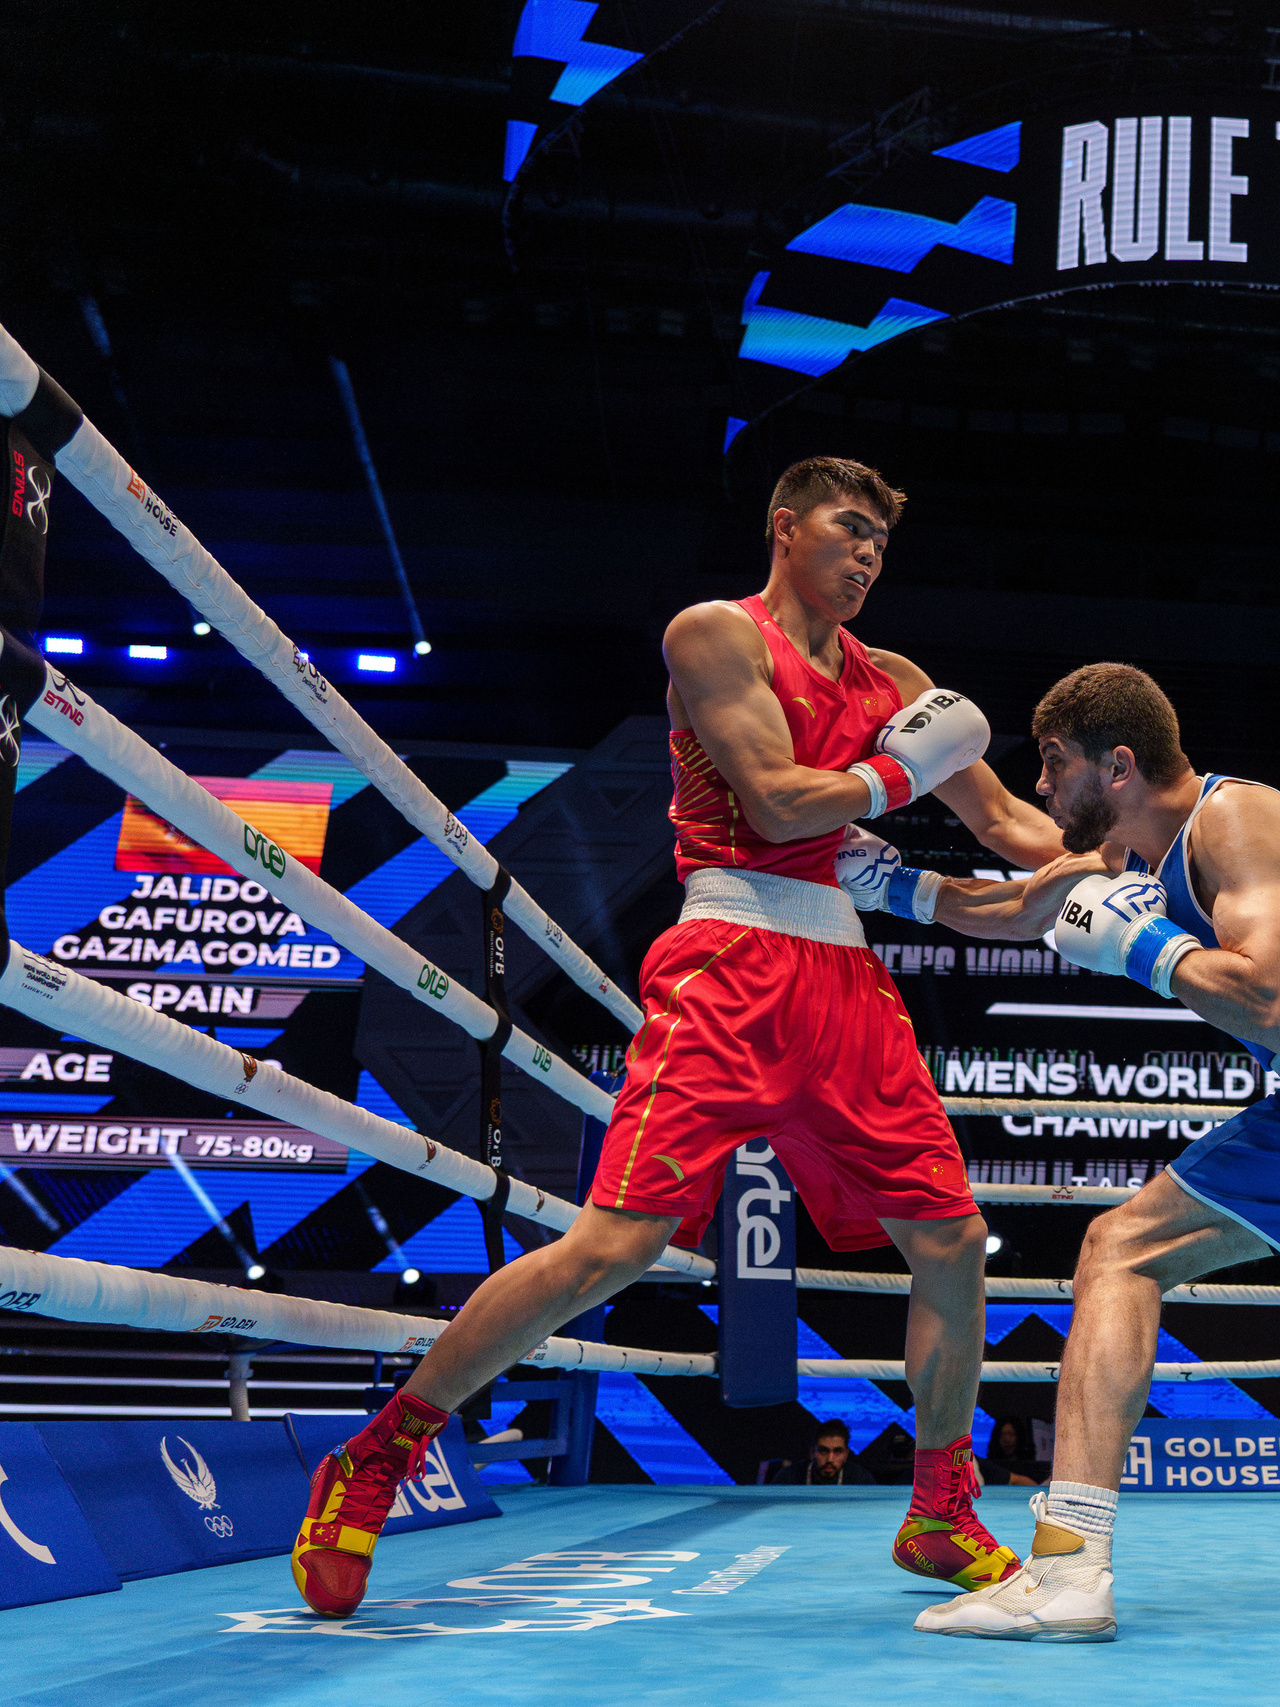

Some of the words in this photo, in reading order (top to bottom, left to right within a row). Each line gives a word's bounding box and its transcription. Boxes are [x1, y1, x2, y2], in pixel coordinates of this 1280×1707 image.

[1057, 116, 1250, 271] RULE
[12, 450, 26, 518] STING
[144, 497, 178, 538] HOUSE
[43, 690, 84, 726] STING
[836, 848, 867, 861] ING
[131, 875, 283, 904] JALIDO
[99, 905, 307, 936] GAFUROVA
[1060, 900, 1093, 934] IBA
[52, 934, 341, 969] GAZIMAGOMED
[495, 937, 505, 974] OFB
[126, 982, 254, 1014] SPAIN
[20, 1053, 113, 1082] AGE
[945, 1060, 1078, 1095] MENS
[1089, 1065, 1255, 1100] WORLD
[12, 1123, 188, 1155] WEIGHT
[196, 1135, 313, 1163] 75-80kg
[1002, 1115, 1227, 1140] CHAMPIO
[0, 1291, 41, 1310] OFB
[393, 1437, 413, 1450] ANTA
[1166, 1465, 1280, 1487] HOUSE
[906, 1541, 936, 1571] CHINA
